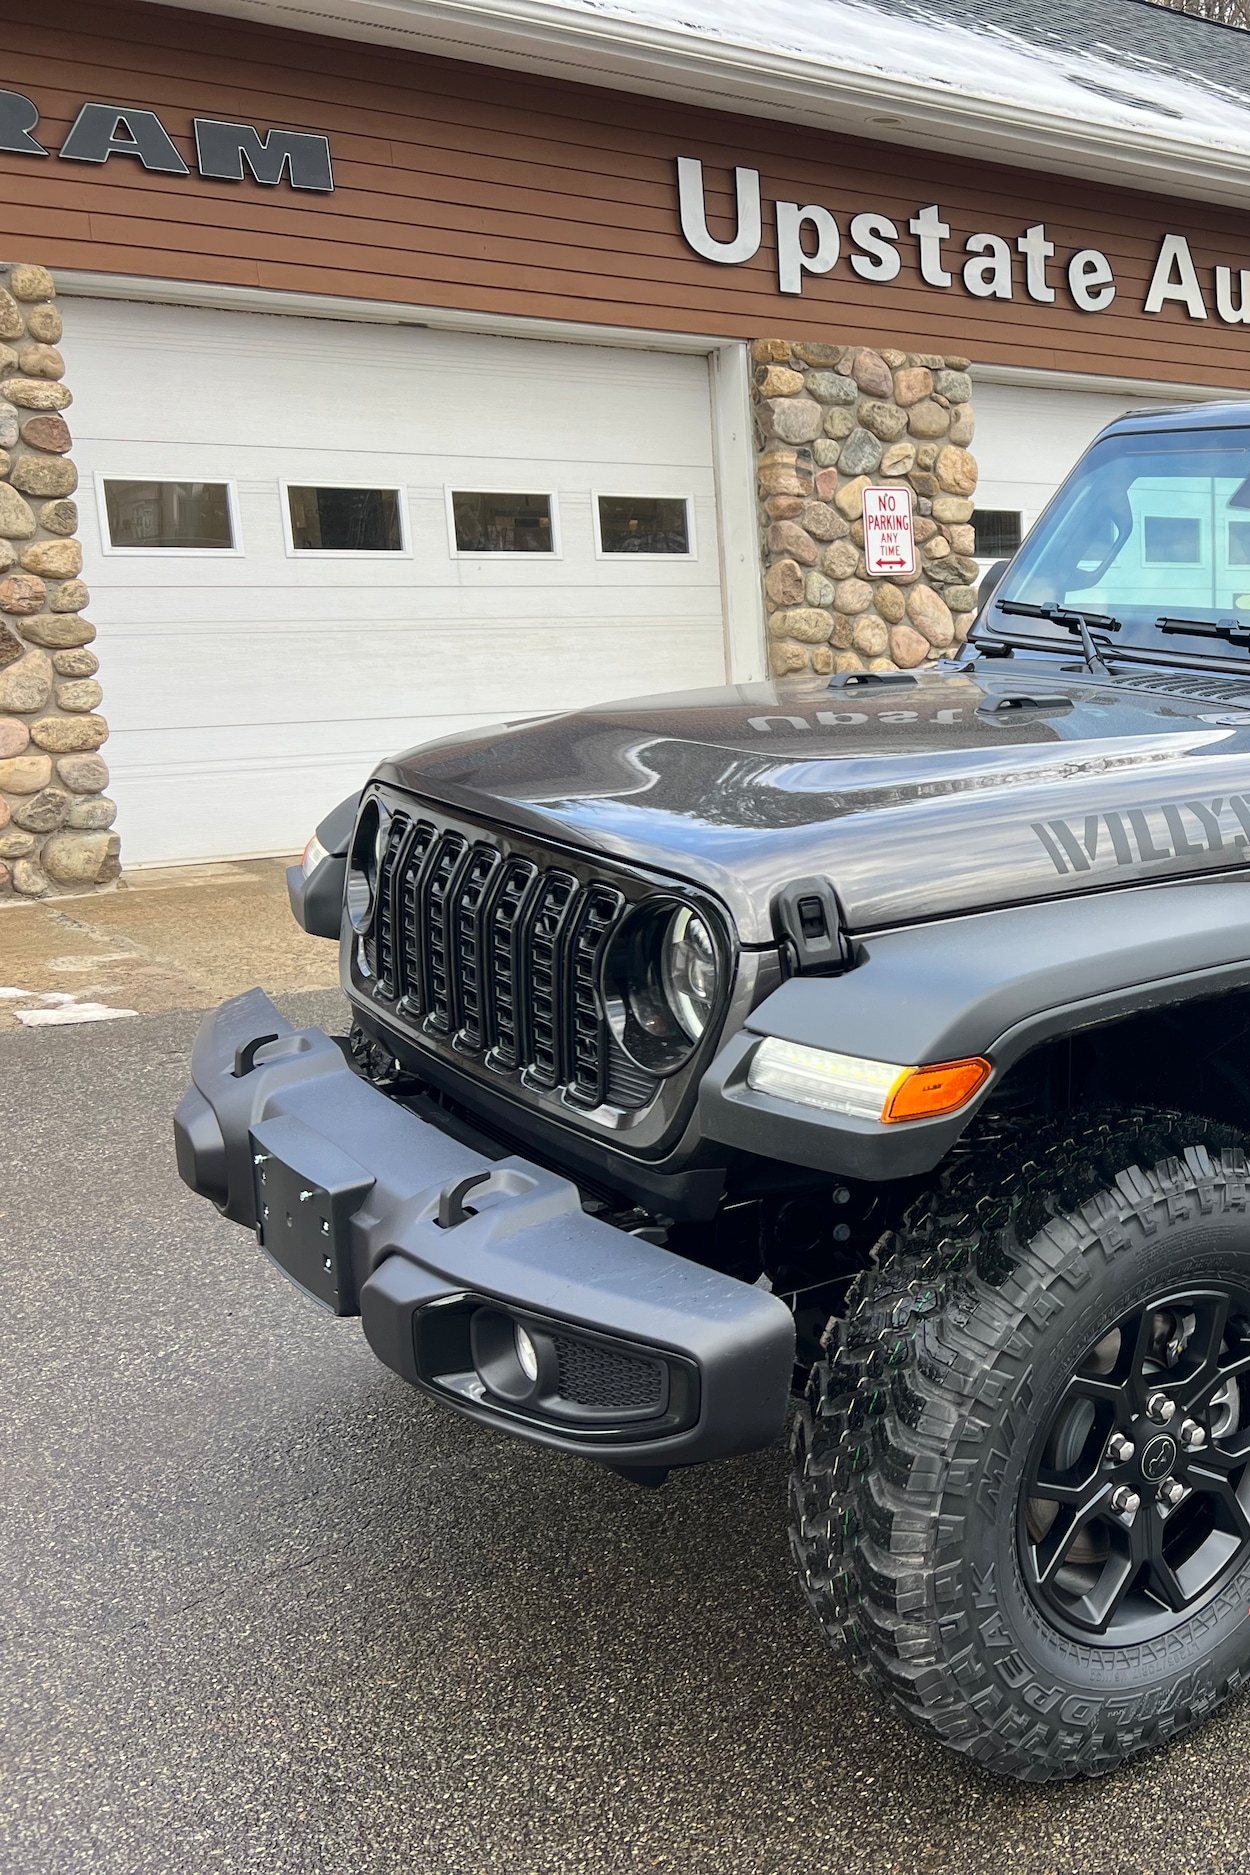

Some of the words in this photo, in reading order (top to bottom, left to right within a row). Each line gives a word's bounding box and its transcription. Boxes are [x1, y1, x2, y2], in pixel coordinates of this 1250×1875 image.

[675, 155, 1117, 314] Upstate
[878, 495, 896, 512] NO
[867, 514, 909, 531] PARKING
[880, 532, 899, 544] ANY
[880, 545, 901, 556] TIME
[970, 1560, 1214, 1729] WILDPEAK
